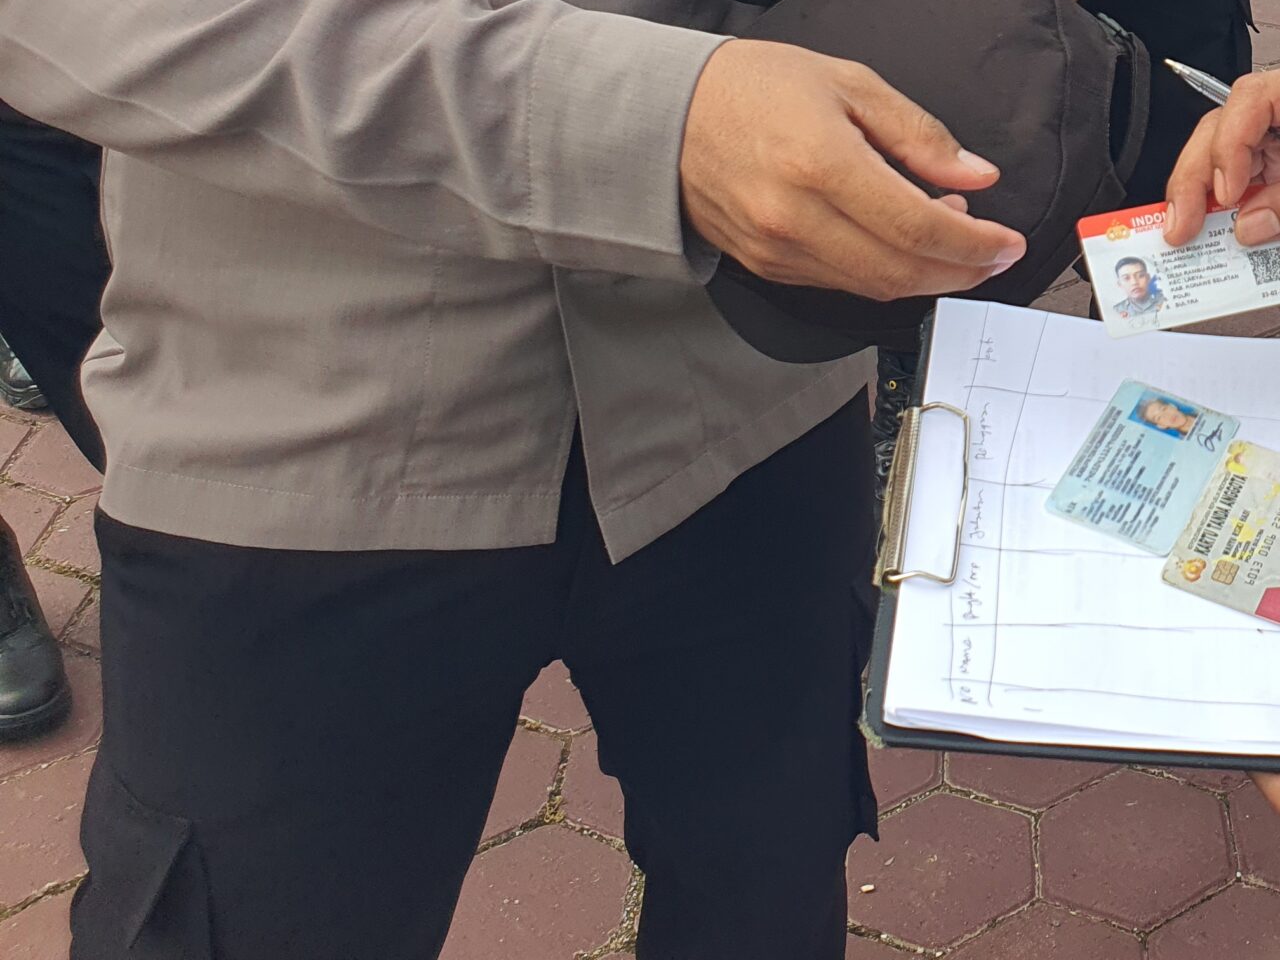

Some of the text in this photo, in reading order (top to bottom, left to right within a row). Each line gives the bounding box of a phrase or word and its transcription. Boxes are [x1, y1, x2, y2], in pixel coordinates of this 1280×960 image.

[1160, 248, 1185, 257] WAHYU
[1204, 240, 1220, 248] HADI
[1217, 471, 1248, 508] ANGGOTA
[1205, 504, 1231, 532] TANDA
[1192, 527, 1219, 557] KARTU
